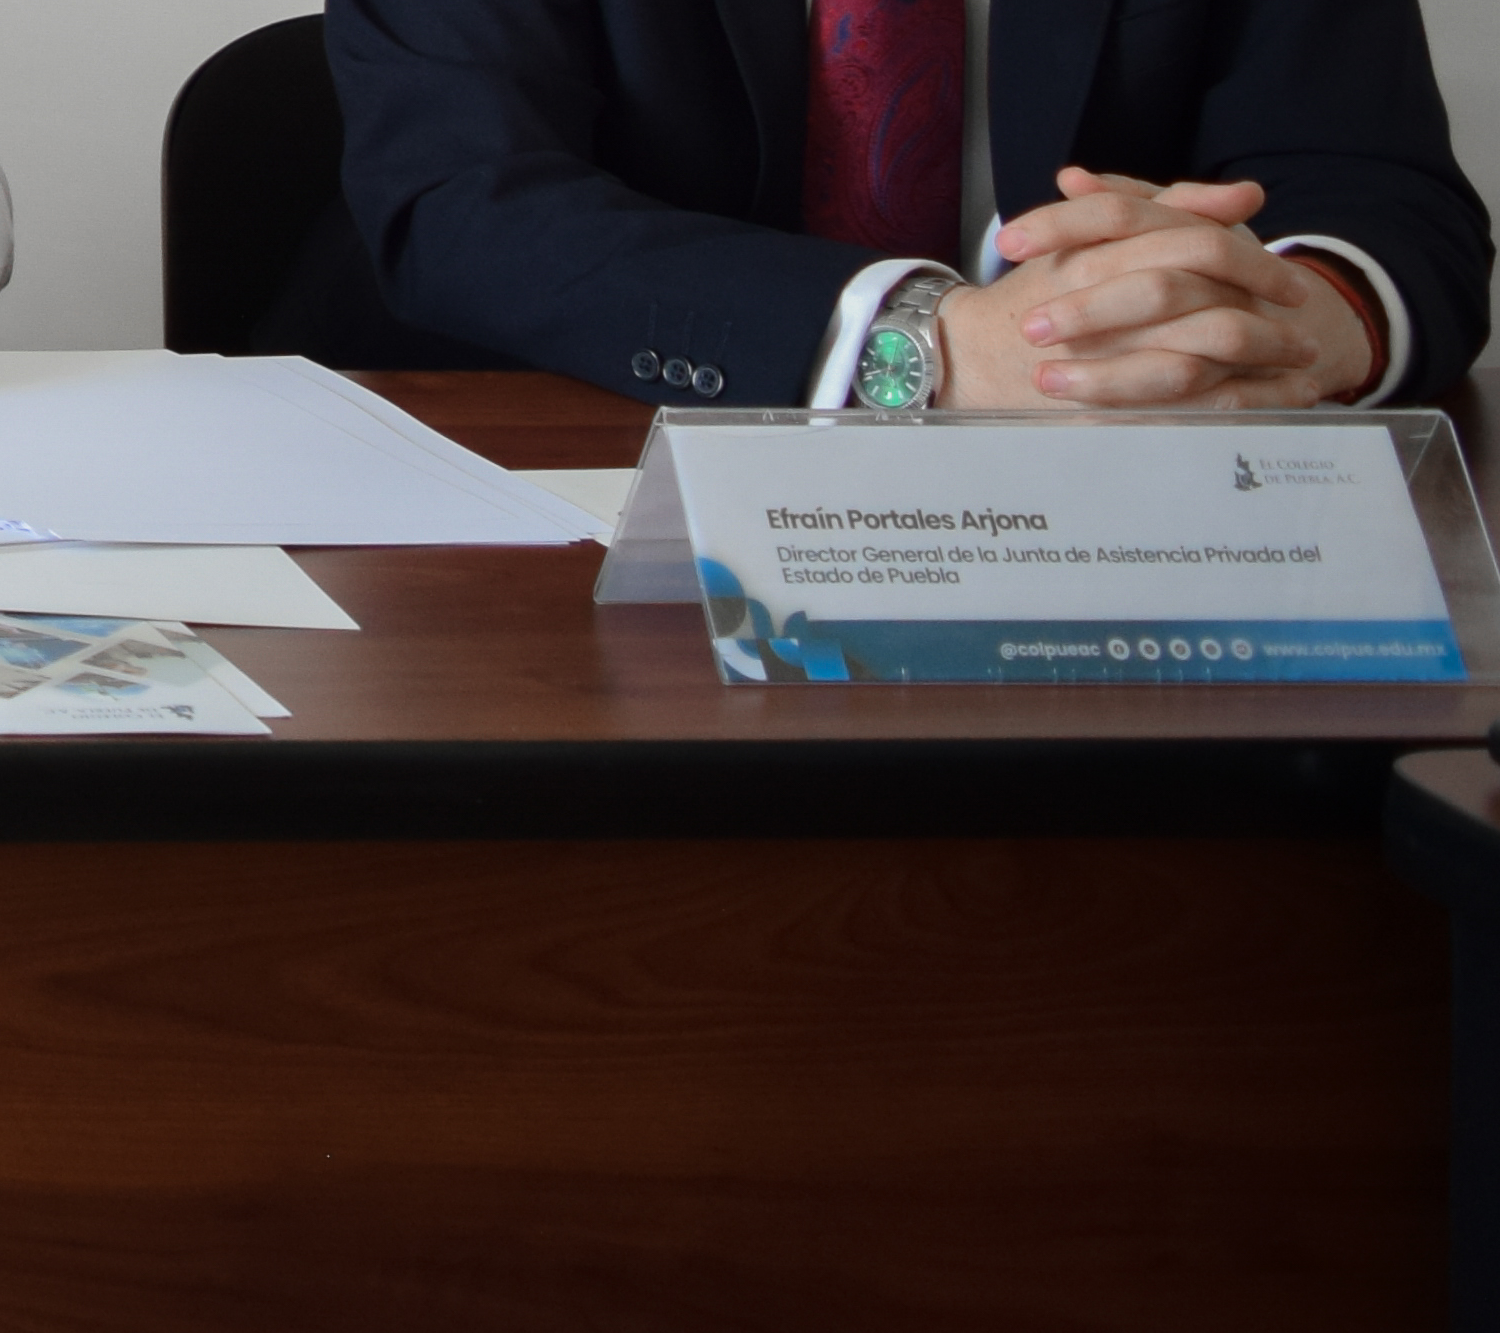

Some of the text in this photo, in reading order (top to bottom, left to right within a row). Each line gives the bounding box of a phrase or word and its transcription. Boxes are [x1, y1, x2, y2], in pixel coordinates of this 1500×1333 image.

[766, 507, 1049, 538] Efraín Portales Arjona
[776, 544, 1323, 565] Director General de la Junta de Asistencia Privada del
[781, 566, 961, 585] Estado de Puebla
